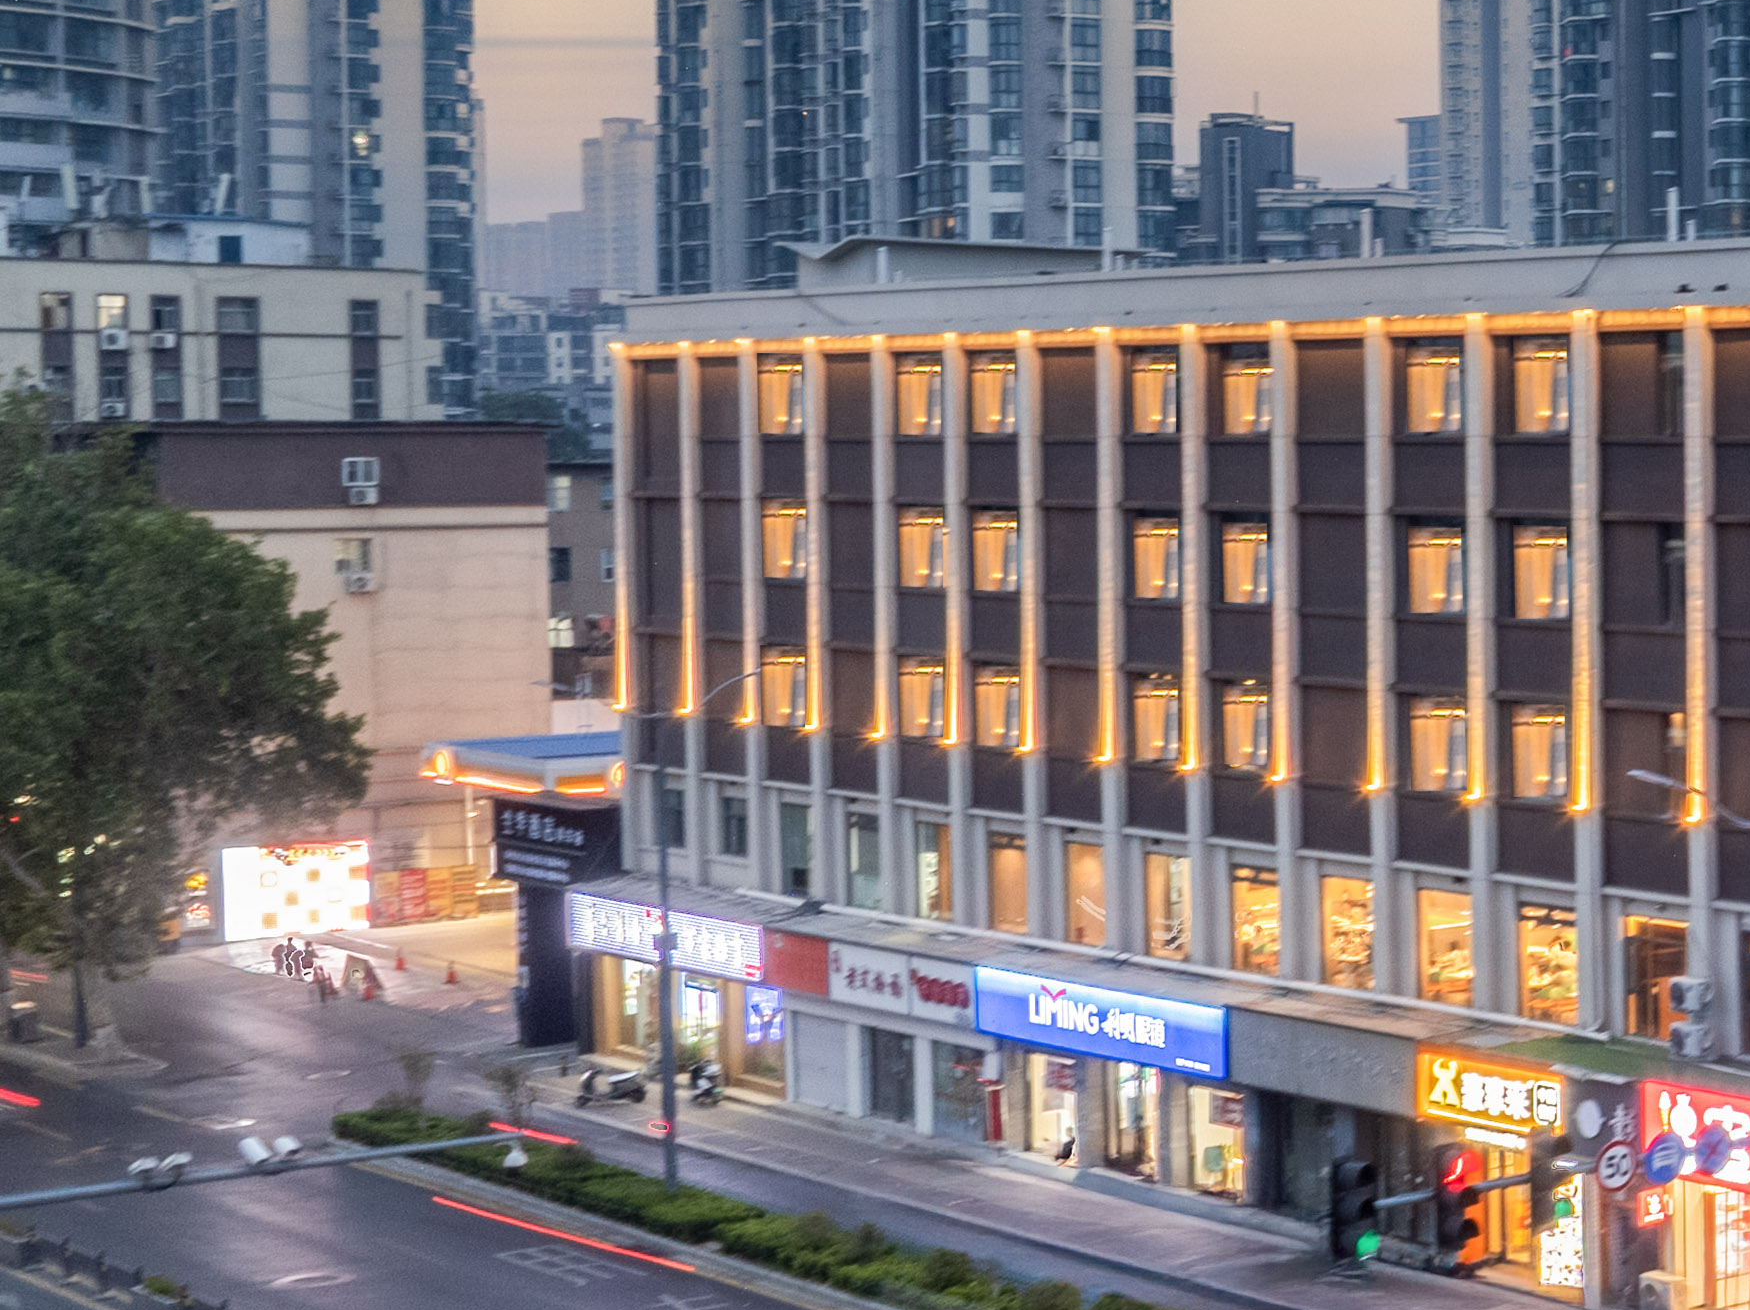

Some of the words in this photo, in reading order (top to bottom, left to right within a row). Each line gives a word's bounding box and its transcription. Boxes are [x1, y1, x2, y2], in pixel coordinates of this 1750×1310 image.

[1028, 993, 1100, 1035] LIMING
[1100, 1007, 1166, 1049] 利明眼镜
[1604, 1152, 1631, 1183] 50
